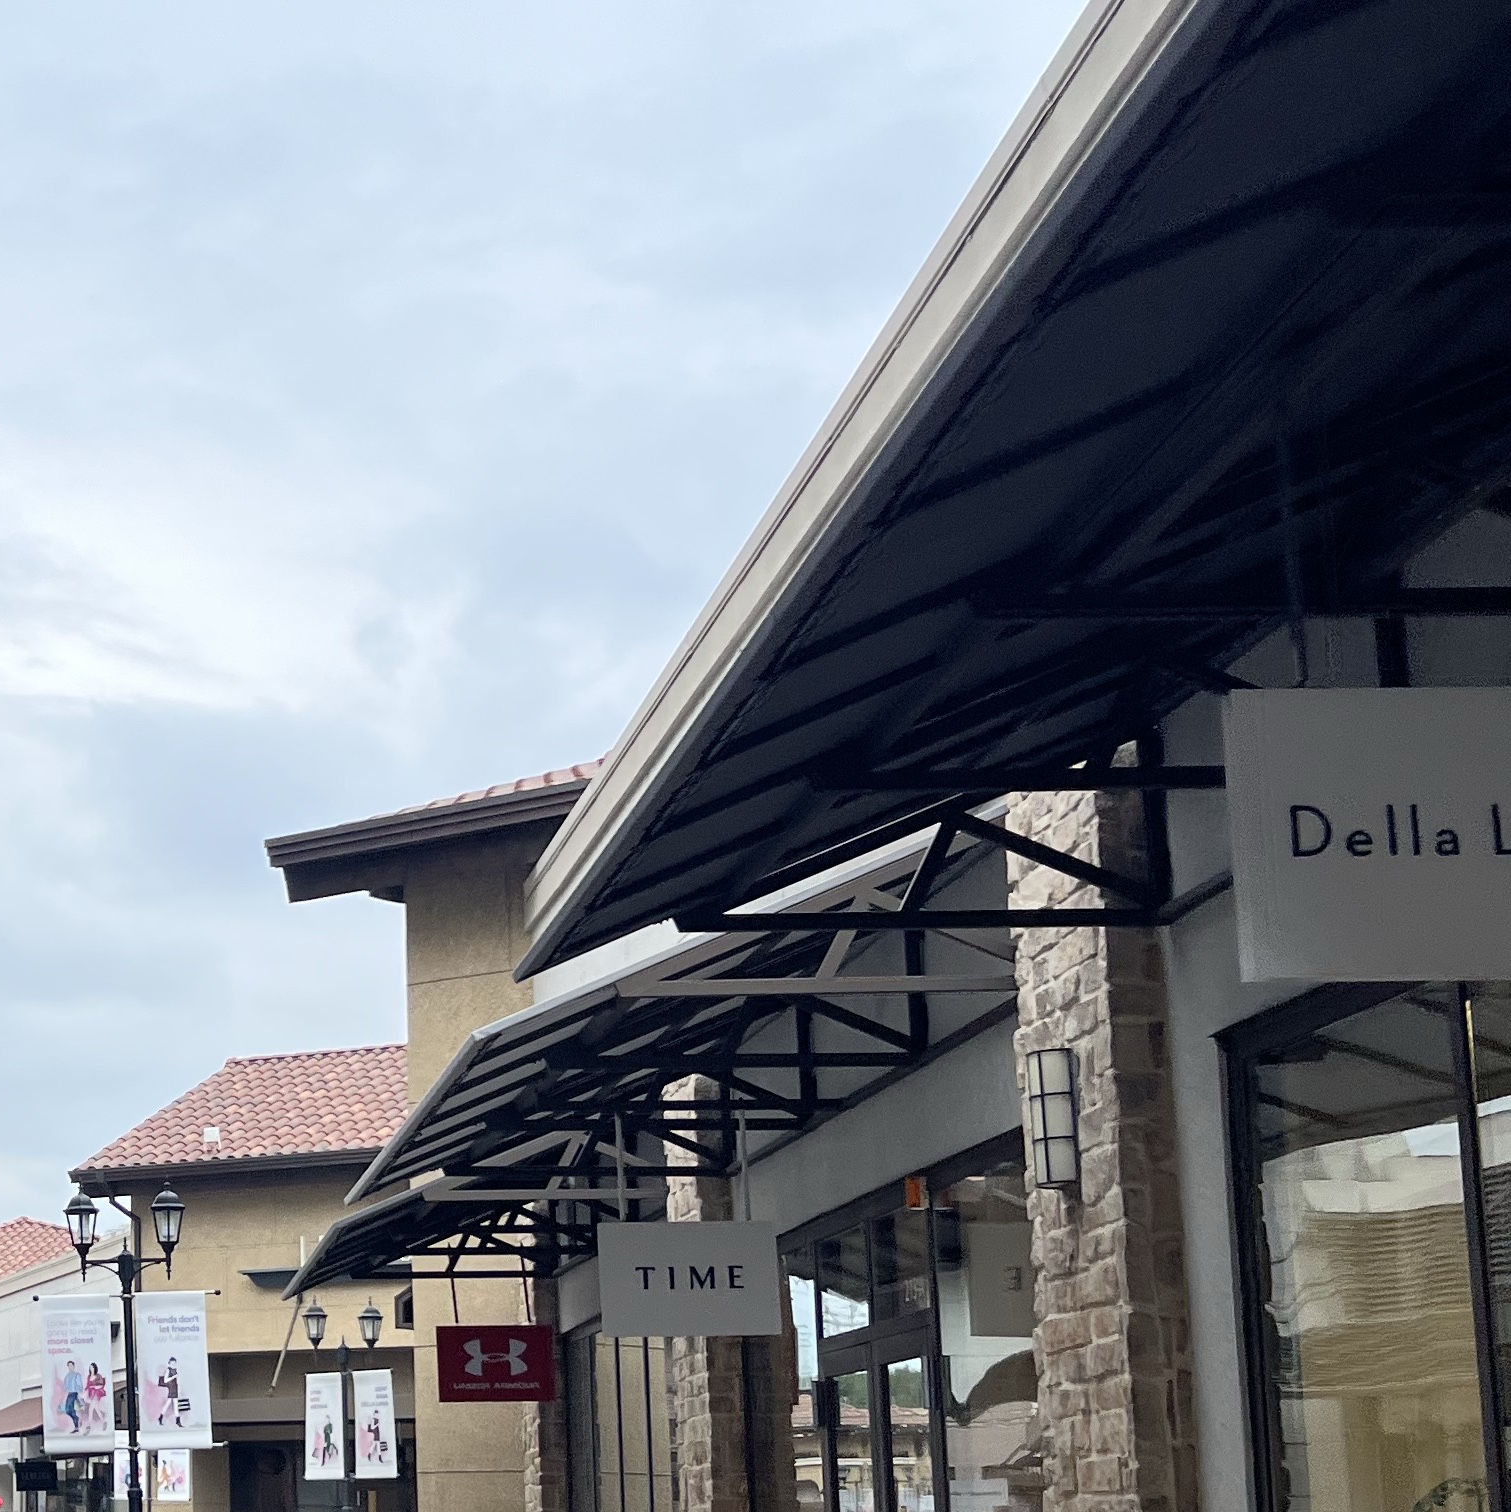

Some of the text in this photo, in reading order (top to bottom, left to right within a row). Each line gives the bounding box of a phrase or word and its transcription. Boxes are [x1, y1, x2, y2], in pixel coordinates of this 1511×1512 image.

[1289, 804, 1461, 858] Della
[634, 1265, 745, 1290] TIME
[147, 1314, 199, 1324] Friends don't
[171, 1324, 200, 1333] friends
